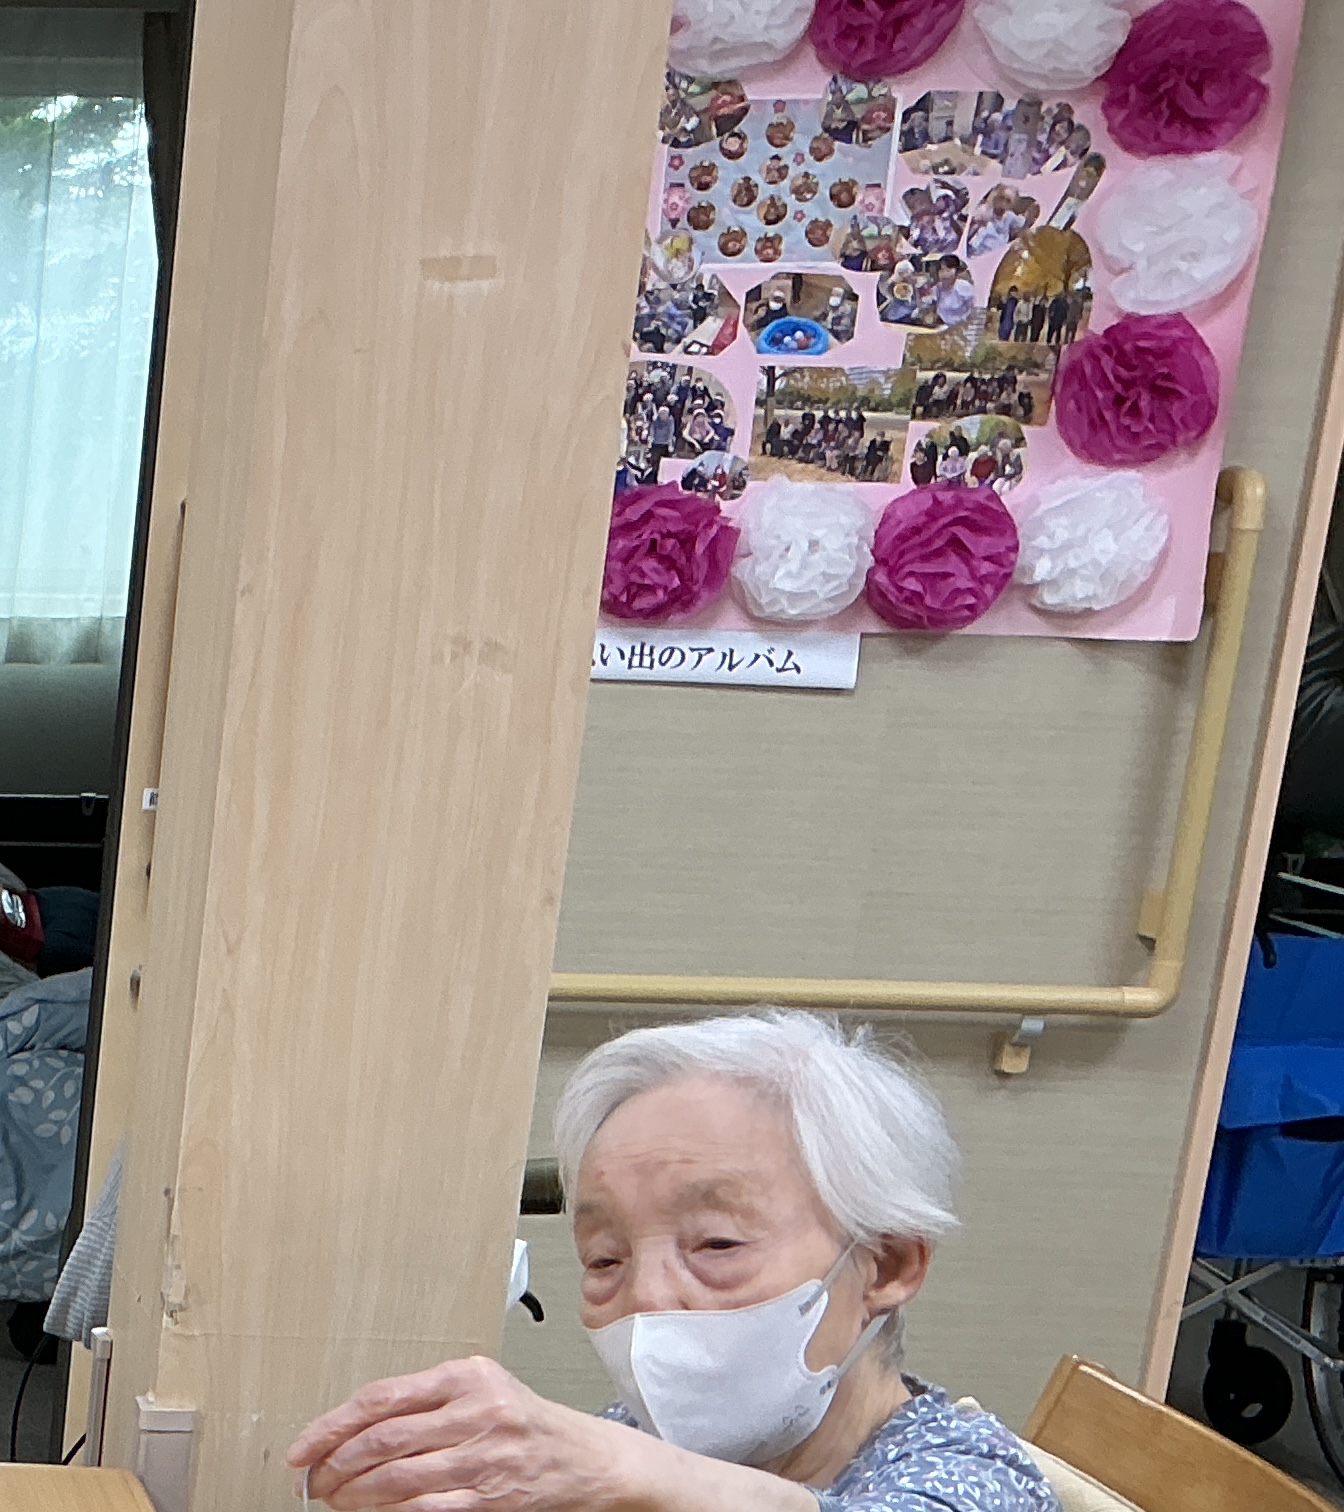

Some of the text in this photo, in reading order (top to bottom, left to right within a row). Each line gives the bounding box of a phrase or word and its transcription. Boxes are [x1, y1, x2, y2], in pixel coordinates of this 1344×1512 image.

[591, 641, 802, 675] い出のアルバム
